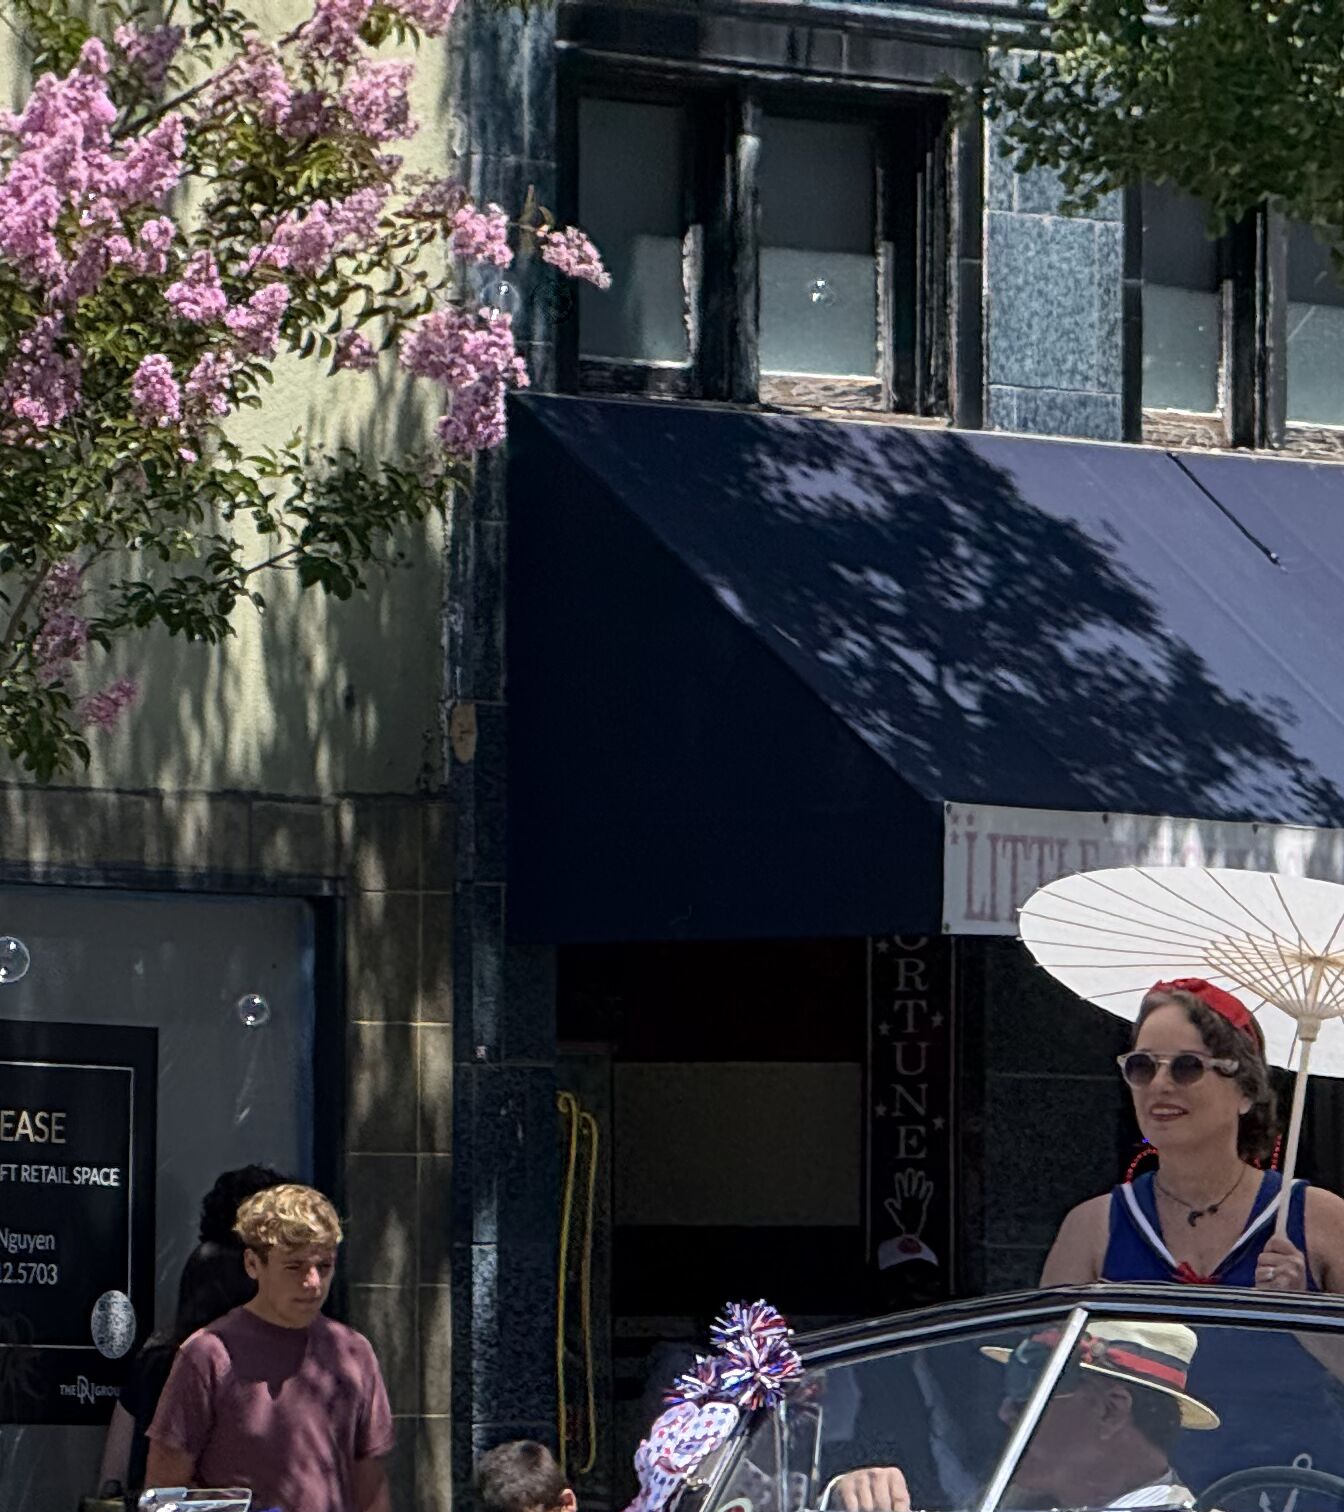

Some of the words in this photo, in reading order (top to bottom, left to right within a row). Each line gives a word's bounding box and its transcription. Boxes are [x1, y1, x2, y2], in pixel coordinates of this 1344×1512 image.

[0, 1163, 18, 1182] FT
[20, 1164, 71, 1185] RETAIL
[72, 1166, 121, 1187] SPACE
[59, 1384, 77, 1396] THE
[96, 1385, 122, 1398] GROU
